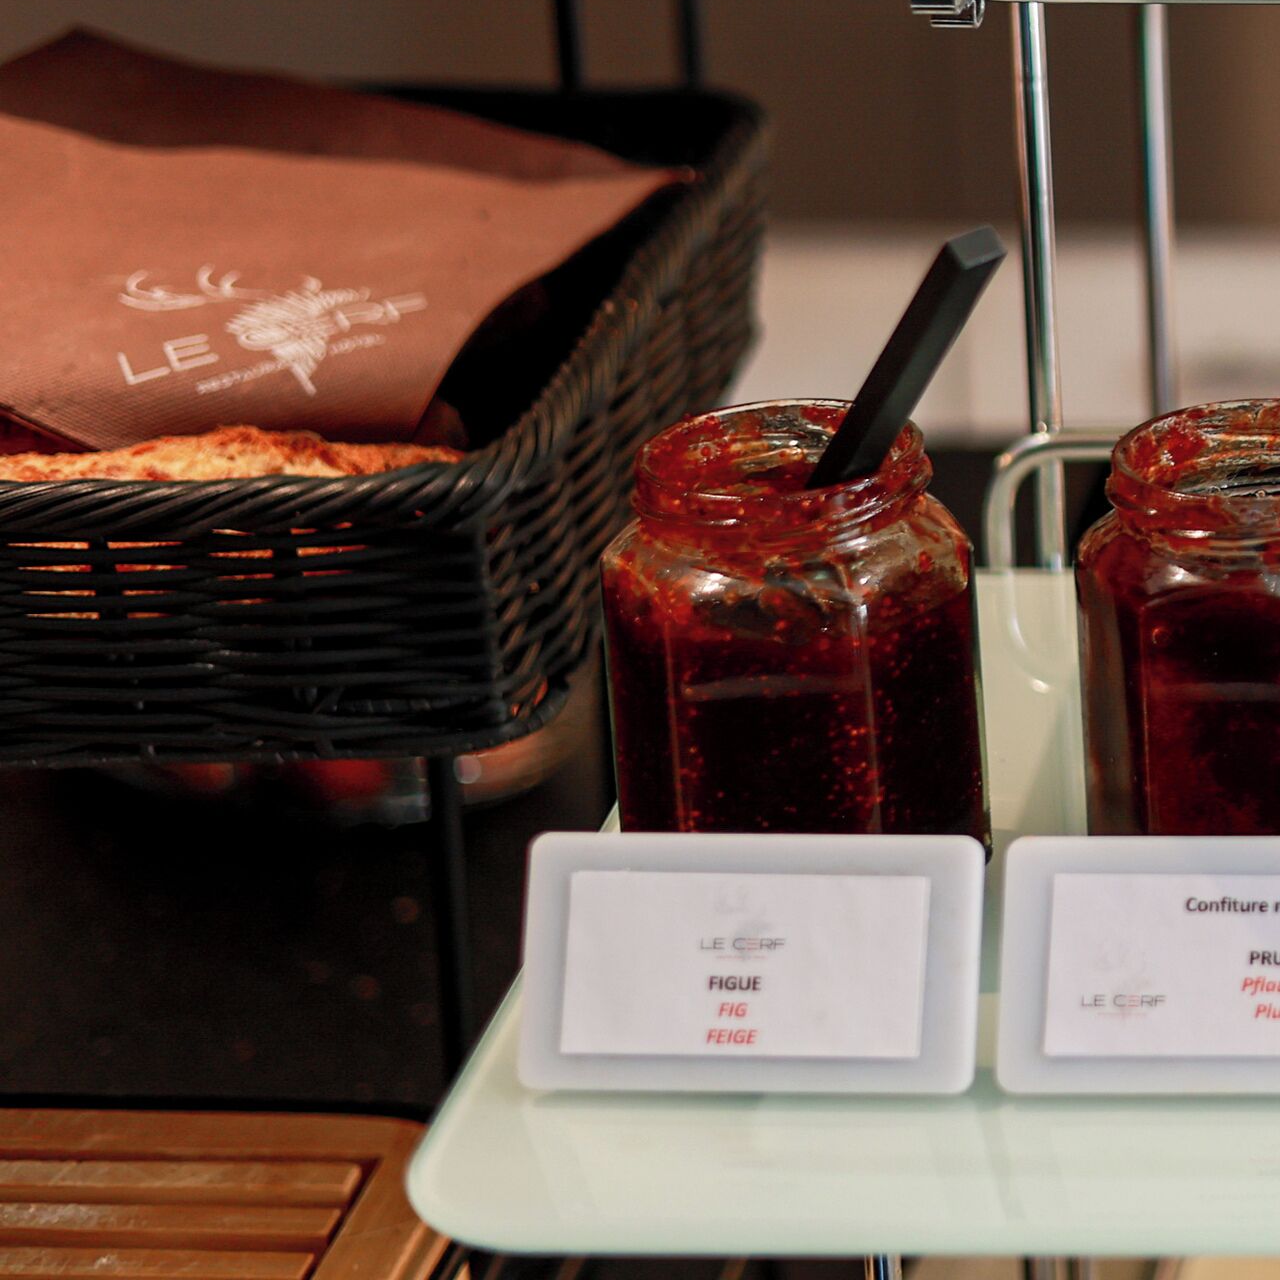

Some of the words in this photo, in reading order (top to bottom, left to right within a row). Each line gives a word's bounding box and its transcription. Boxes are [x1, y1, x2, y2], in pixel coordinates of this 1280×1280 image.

[117, 333, 220, 387] LE
[1185, 897, 1269, 914] Confiture
[700, 937, 725, 950] LE
[733, 937, 787, 950] CERF
[708, 975, 762, 992] FIGUE
[1081, 994, 1105, 1007] LE
[1113, 994, 1166, 1008] CERF
[718, 1002, 748, 1018] FIG
[706, 1028, 759, 1045] FEIGE
